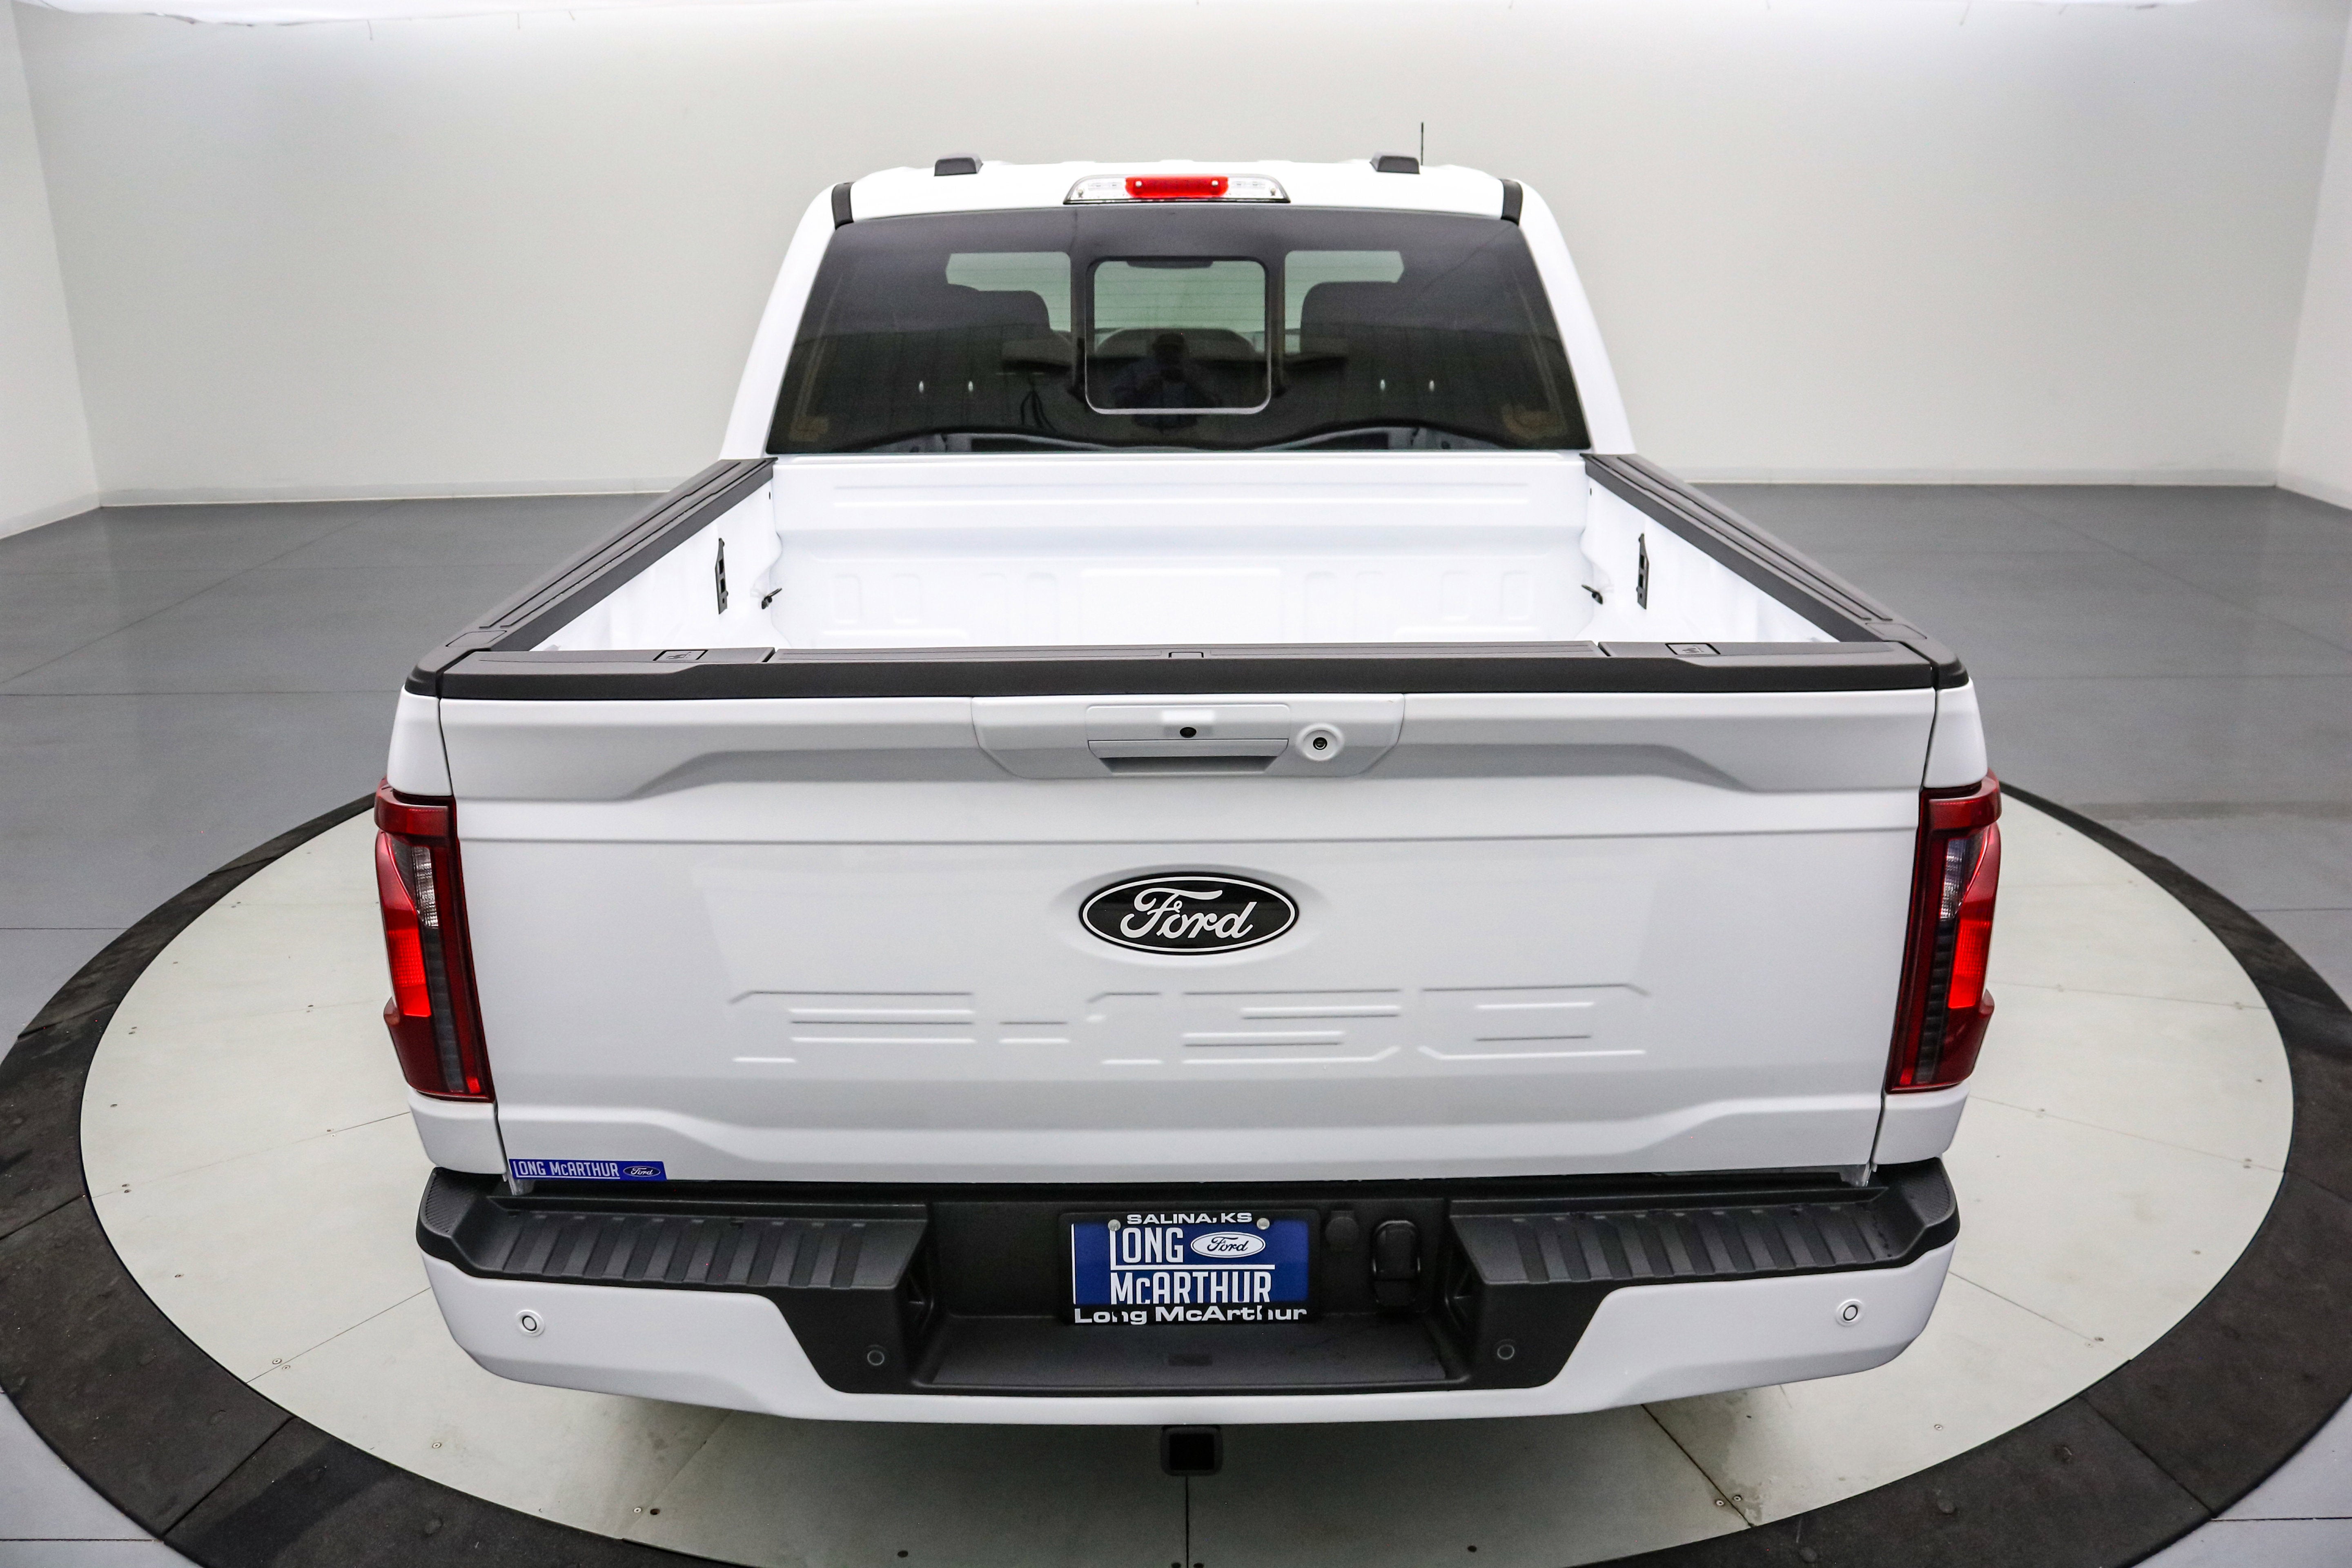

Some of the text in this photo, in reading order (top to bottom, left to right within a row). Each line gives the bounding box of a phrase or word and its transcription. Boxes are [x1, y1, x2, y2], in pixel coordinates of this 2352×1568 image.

[1120, 887, 1257, 938] Ford
[727, 982, 1650, 1065] F-150
[513, 1160, 654, 1178] LONG McARTHUR Ford
[1127, 1212, 1253, 1225] SALINA, KS
[1110, 1226, 1249, 1270] LONG Ford
[1110, 1271, 1272, 1305] McARTHUR
[1074, 1305, 1307, 1325] Long McArthur
